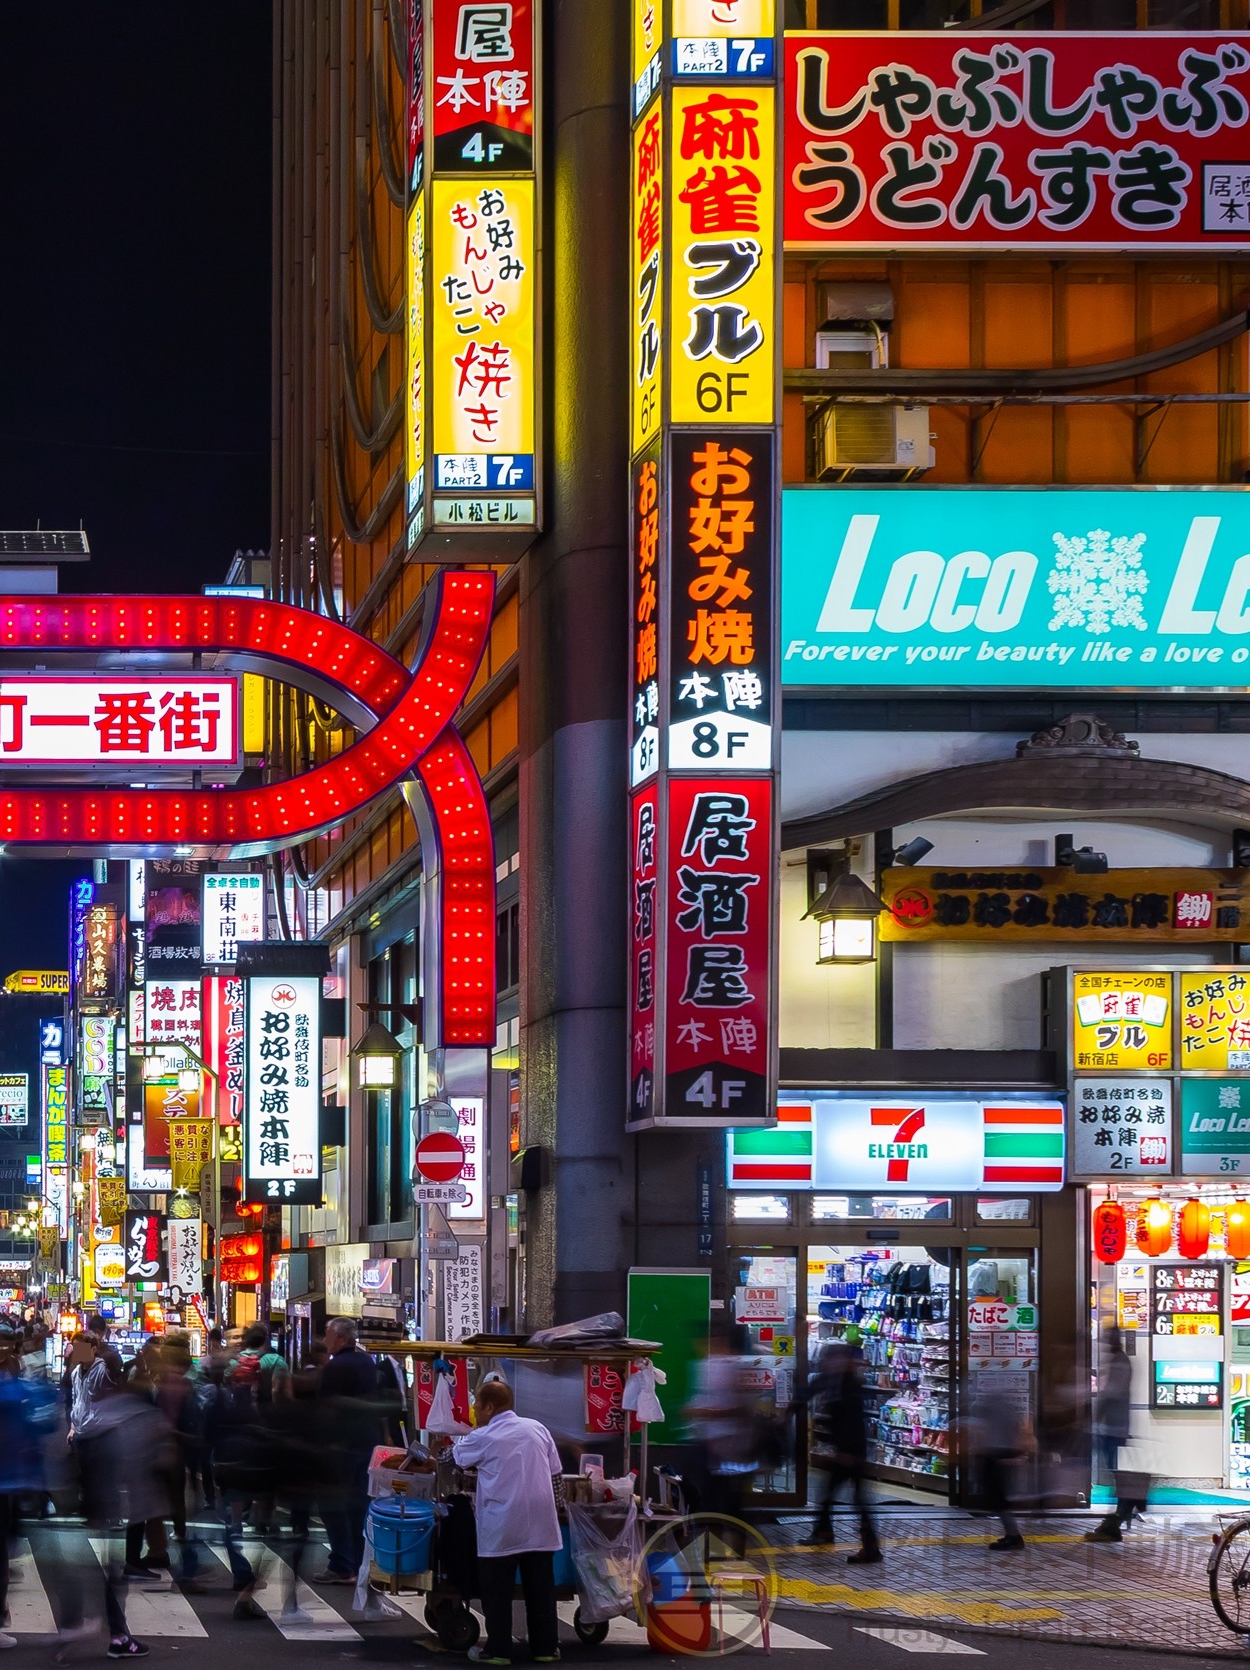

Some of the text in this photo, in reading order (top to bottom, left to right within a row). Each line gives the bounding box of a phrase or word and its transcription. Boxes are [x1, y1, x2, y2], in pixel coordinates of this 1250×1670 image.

[455, 3, 514, 63] 屋
[683, 60, 723, 72] PART2
[731, 40, 766, 72] 7F
[436, 68, 530, 113] 本陣
[796, 43, 1250, 139] しゃぶしゃぶ
[461, 133, 504, 163] 4F
[792, 134, 1192, 231] うどんすき
[1220, 199, 1250, 224] 本
[480, 188, 524, 282] お好み
[678, 94, 764, 363] 麻雀ブル
[637, 111, 662, 383] 麻雀ブル
[451, 203, 506, 326] もんじゃ
[454, 341, 512, 445] 焼き
[695, 372, 749, 413] 6F
[640, 384, 656, 434] 6F
[444, 475, 481, 486] PART2
[492, 456, 524, 485] 7F
[448, 504, 519, 523] 小松ビル
[688, 442, 755, 666] お好み焼
[637, 460, 658, 684] お好み焼
[815, 514, 1039, 634] Loco
[784, 640, 1223, 665] Forever your beauty like a love
[679, 669, 762, 710] 本陣
[639, 736, 654, 771] 8F
[692, 720, 749, 759] 8F
[207, 877, 260, 888] 全卓全自動
[636, 802, 656, 1011] 居酒屋
[676, 792, 760, 1008] 居酒屋
[219, 892, 238, 962] 東南荘
[41, 974, 68, 989] SUPER
[1080, 977, 1166, 989] 全国チェーンの店
[1185, 975, 1246, 1008] お好み
[151, 986, 200, 1012] 焼肉
[1103, 994, 1141, 1016] 麻雀
[151, 1020, 200, 1031] 韓国料理
[676, 1015, 756, 1055] 本陣
[1097, 1026, 1148, 1049] ブル
[295, 1013, 309, 1088] 歌舞伎町名物
[1078, 1052, 1168, 1066] 新宿店 6F
[260, 1010, 291, 1166] お好み焼本陣
[636, 1073, 651, 1108] 4F
[685, 1070, 746, 1108] 4F
[1083, 1088, 1163, 1100] 歌舞伎町名物
[48, 1068, 66, 1162] まんが喫茶
[1079, 1105, 1166, 1124] お好み焼
[1189, 1112, 1225, 1132] Loco
[174, 1125, 210, 1135] 悪質な
[174, 1138, 210, 1149] 客引き
[1094, 1128, 1138, 1146] 本陣
[174, 1151, 210, 1162] に注意
[1110, 1153, 1133, 1169] 2F
[1220, 1157, 1240, 1171] 3F
[267, 1180, 296, 1196] 2F
[418, 1188, 463, 1199] 自転車を除く
[700, 1234, 712, 1243] 17
[470, 1250, 480, 1334] みなさまの安全を守り
[1156, 1269, 1174, 1287] 8F
[459, 1255, 470, 1336] 防犯カメラ作動
[746, 1289, 778, 1300] ATM
[1156, 1295, 1174, 1311] 7F
[969, 1307, 1034, 1324] たばこ 酒
[1156, 1317, 1173, 1334] 6F
[1157, 1386, 1174, 1404] 2F
